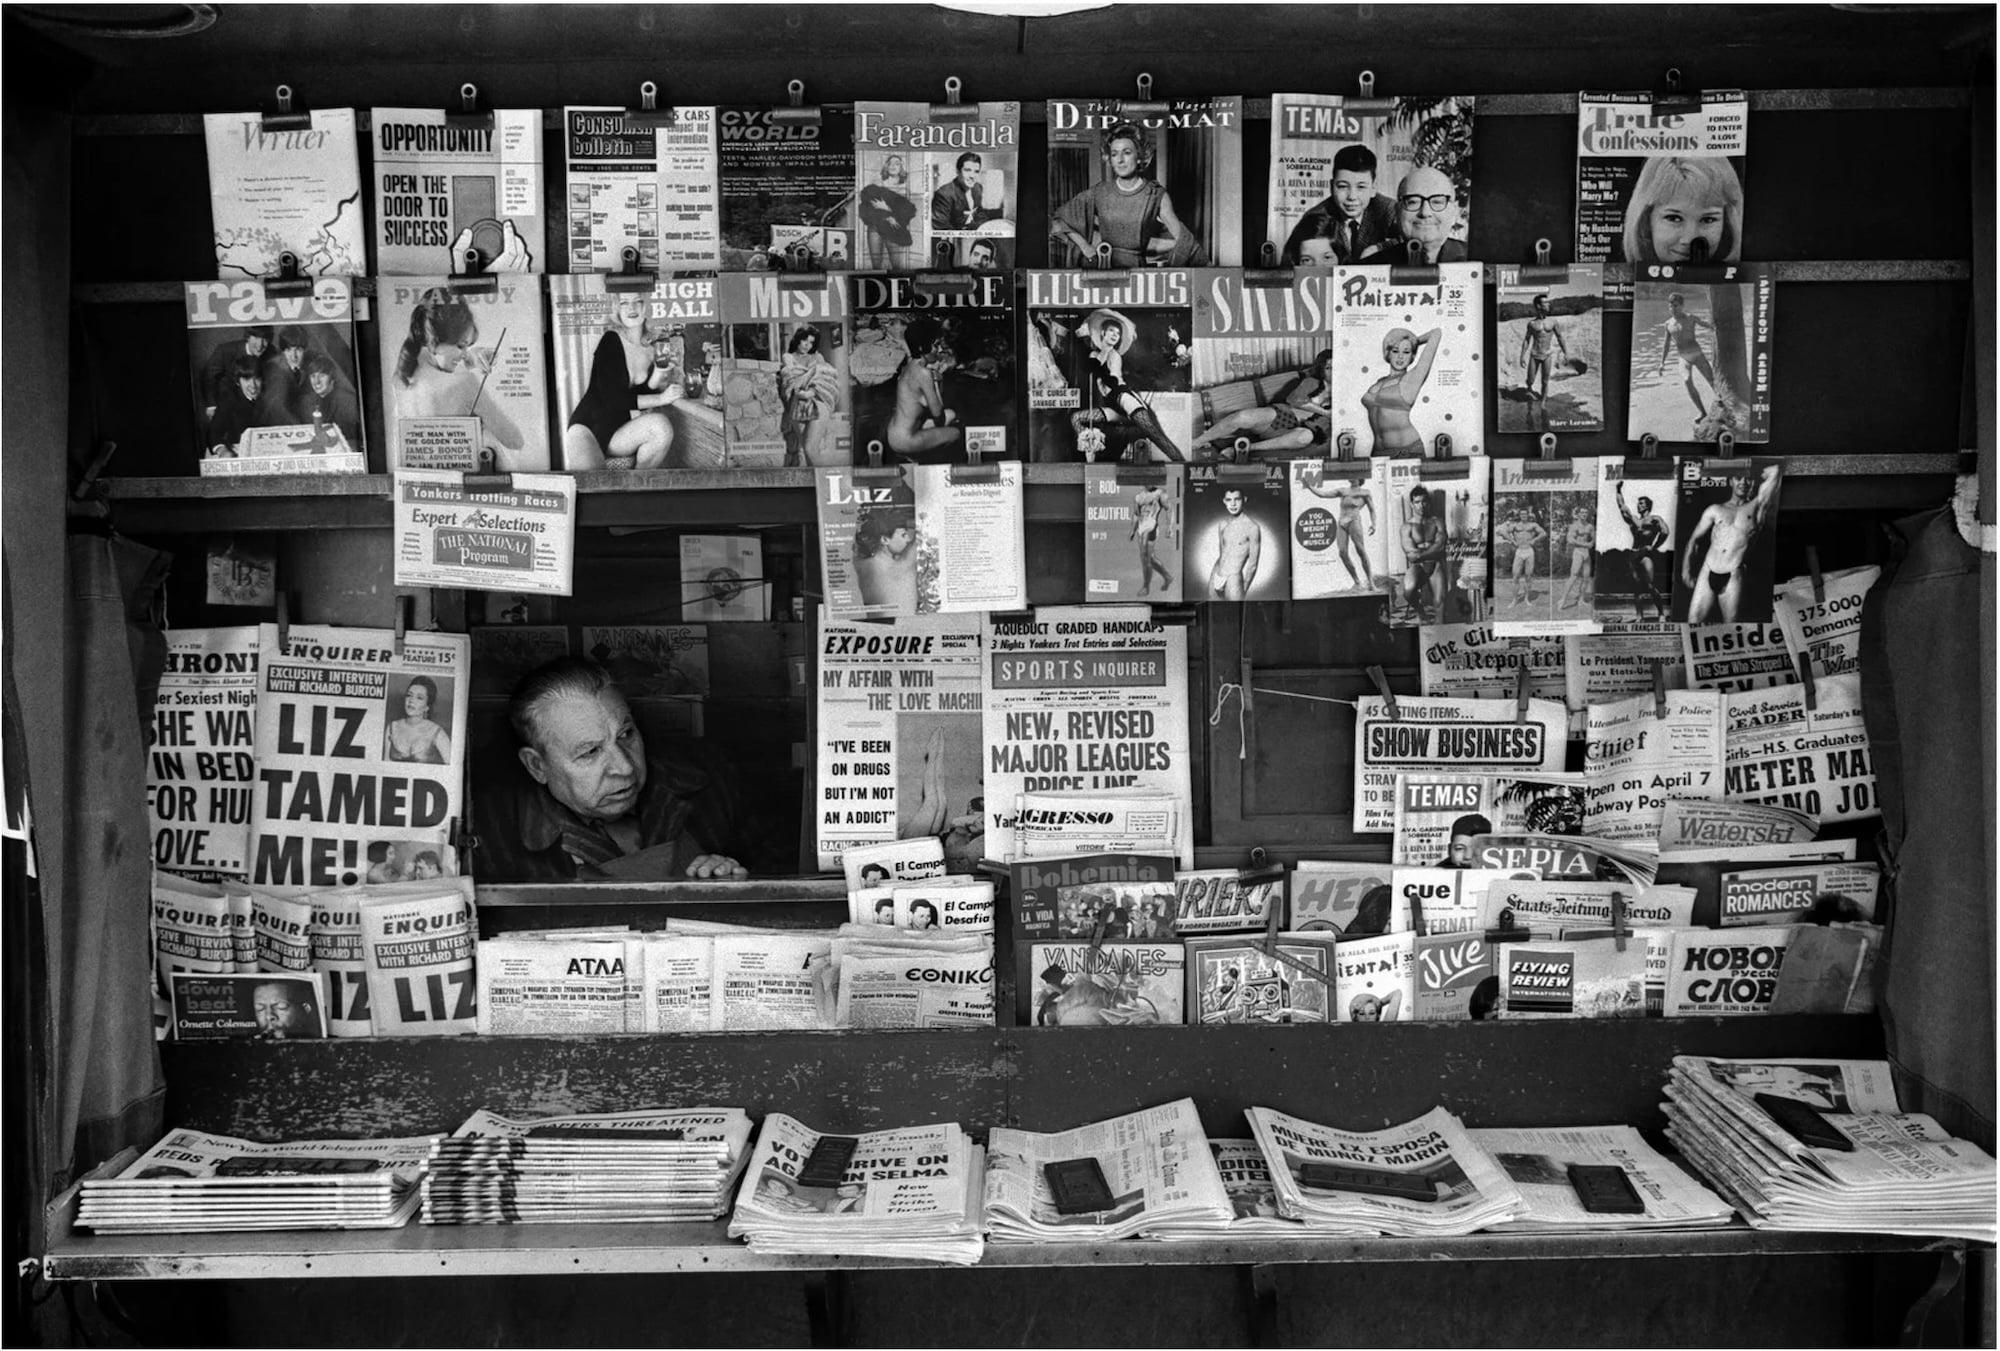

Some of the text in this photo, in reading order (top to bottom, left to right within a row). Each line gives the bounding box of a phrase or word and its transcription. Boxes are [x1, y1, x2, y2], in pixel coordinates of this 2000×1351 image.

[684, 110, 710, 121] CARS
[1286, 107, 1360, 134] TEMAS
[1588, 107, 1686, 132] True
[1709, 115, 1741, 123] FORCED
[722, 126, 820, 140] WORLD
[856, 112, 1015, 149] Farándula
[1718, 124, 1742, 132] ENTER
[1582, 123, 1699, 154] Confessions
[1706, 142, 1741, 150] CONTEST
[1286, 164, 1324, 172] SOBRESALE
[1298, 157, 1332, 165] GARDNER
[383, 174, 448, 194] OPEN THE
[1598, 181, 1613, 190] Will
[384, 196, 449, 217] DOOR TO
[384, 219, 449, 247] SUCCESS
[1591, 223, 1623, 233] Husband
[650, 282, 713, 299] HIGH
[189, 279, 350, 323] rave
[651, 301, 714, 318] BALL
[1212, 275, 1333, 333] SMAS
[1032, 389, 1049, 398] THE
[406, 446, 434, 454] JAMES
[412, 486, 559, 508] Yonkers Races
[826, 475, 893, 505] Luz
[412, 508, 546, 533] Expert Selections
[1088, 506, 1131, 521] BEAUTIFUL
[439, 534, 466, 550] THE
[467, 533, 529, 556] NATIONAL
[460, 547, 510, 566] Program
[1797, 594, 1862, 623] 375,000
[994, 621, 1165, 636] AQUEDUCT GRADED HANDICAPS
[824, 636, 934, 654] EXPOSURE
[991, 638, 1167, 650] 3 Nights Yonkers Trot Entries and Selections
[1426, 640, 1458, 665] The
[281, 645, 393, 664] ENQUIRER
[402, 654, 437, 664] FEATURE
[1580, 656, 1590, 665] Le
[1002, 660, 1156, 681] SPORTS INQUIRER
[1588, 667, 1606, 676] aux
[1697, 655, 1785, 678] The Star Who Stripped
[269, 667, 384, 686] EXCLUSIVE INTERVIEW
[823, 670, 934, 688] MY AFFAIR WITH
[174, 690, 224, 705] Sexiest
[270, 680, 384, 698] WITH RICHARD BURTON
[867, 693, 932, 711] THE LOVE
[1728, 700, 1804, 718] Civil Service
[1365, 706, 1379, 717] 45
[1679, 706, 1712, 716] Police
[277, 703, 368, 759] LIZ
[1006, 710, 1155, 741] NEW, REVISED
[827, 740, 891, 754] "I'VE BEEN
[1371, 726, 1538, 759] SHOW BUSINESS
[1585, 731, 1648, 760] Chief
[1794, 733, 1866, 752] Graduates
[991, 741, 1171, 773] MAJOR LEAGUES
[152, 752, 186, 780] IN
[831, 763, 891, 776] ON DRUGS
[1622, 771, 1712, 791] on April 7
[1725, 755, 1817, 796] METER
[259, 768, 449, 829] TAMED
[825, 787, 895, 800] BUT I'M NOT
[1363, 790, 1378, 802] TO
[1408, 785, 1479, 807] TEMAS
[824, 811, 841, 825] AN
[1364, 809, 1382, 818] Films
[1365, 820, 1379, 828] Add
[253, 834, 359, 887] ME!
[895, 862, 905, 872] El
[1482, 847, 1591, 874] SEPIA
[1020, 857, 1159, 889] Bohemia
[1403, 883, 1451, 899] cue
[1727, 877, 1812, 894] modern
[944, 902, 955, 911] El
[1726, 890, 1813, 914] ROMANCES
[383, 911, 420, 920] NATIONAL
[1021, 910, 1055, 923] LA VIDA
[377, 942, 431, 956] EXCLUSIVE
[379, 951, 452, 968] WITH RICHARD
[566, 957, 625, 975] ΑΤΛΑ
[1511, 961, 1571, 974] FLYING
[177, 981, 235, 996] down
[1511, 976, 1571, 988] REVIEW
[187, 997, 237, 1010] beat
[394, 968, 478, 1023] LIZ
[179, 1018, 258, 1029] Ornette Coleman
[610, 1116, 727, 1128] THREATENED
[1270, 1123, 1443, 1156] MUERE EX ESPOSA
[1274, 1135, 1301, 1152] DE
[153, 1149, 204, 1164] REDS
[917, 1154, 949, 1166] ON
[871, 1168, 949, 1180] SELMA
[887, 1205, 939, 1214] Threat
[889, 1198, 936, 1206] Strike
